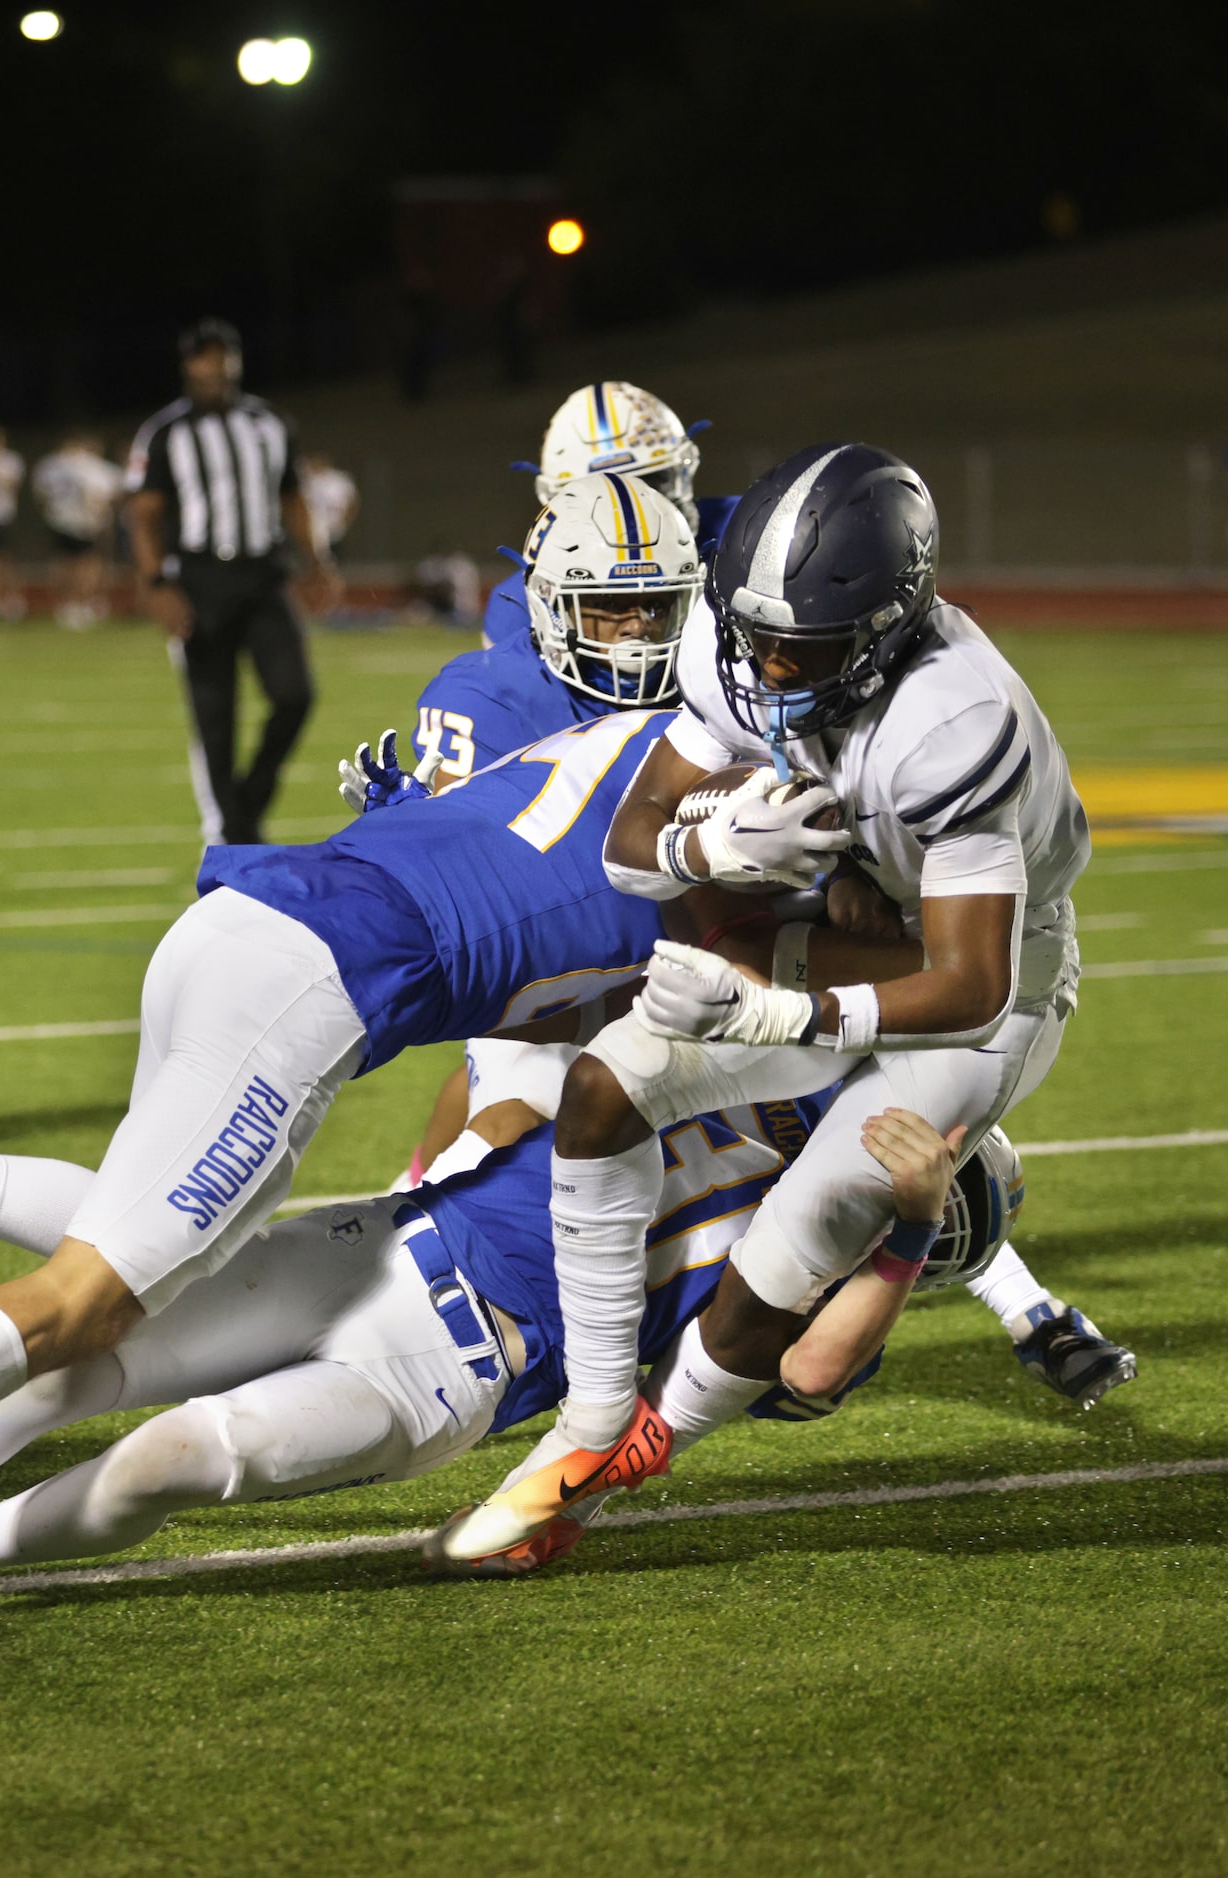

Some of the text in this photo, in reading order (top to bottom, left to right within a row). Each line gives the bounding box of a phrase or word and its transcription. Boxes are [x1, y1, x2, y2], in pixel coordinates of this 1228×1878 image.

[614, 564, 658, 576] RACCOONS
[415, 706, 476, 778] 43
[167, 1074, 290, 1231] RACCOONS
[584, 1416, 665, 1496] POR
